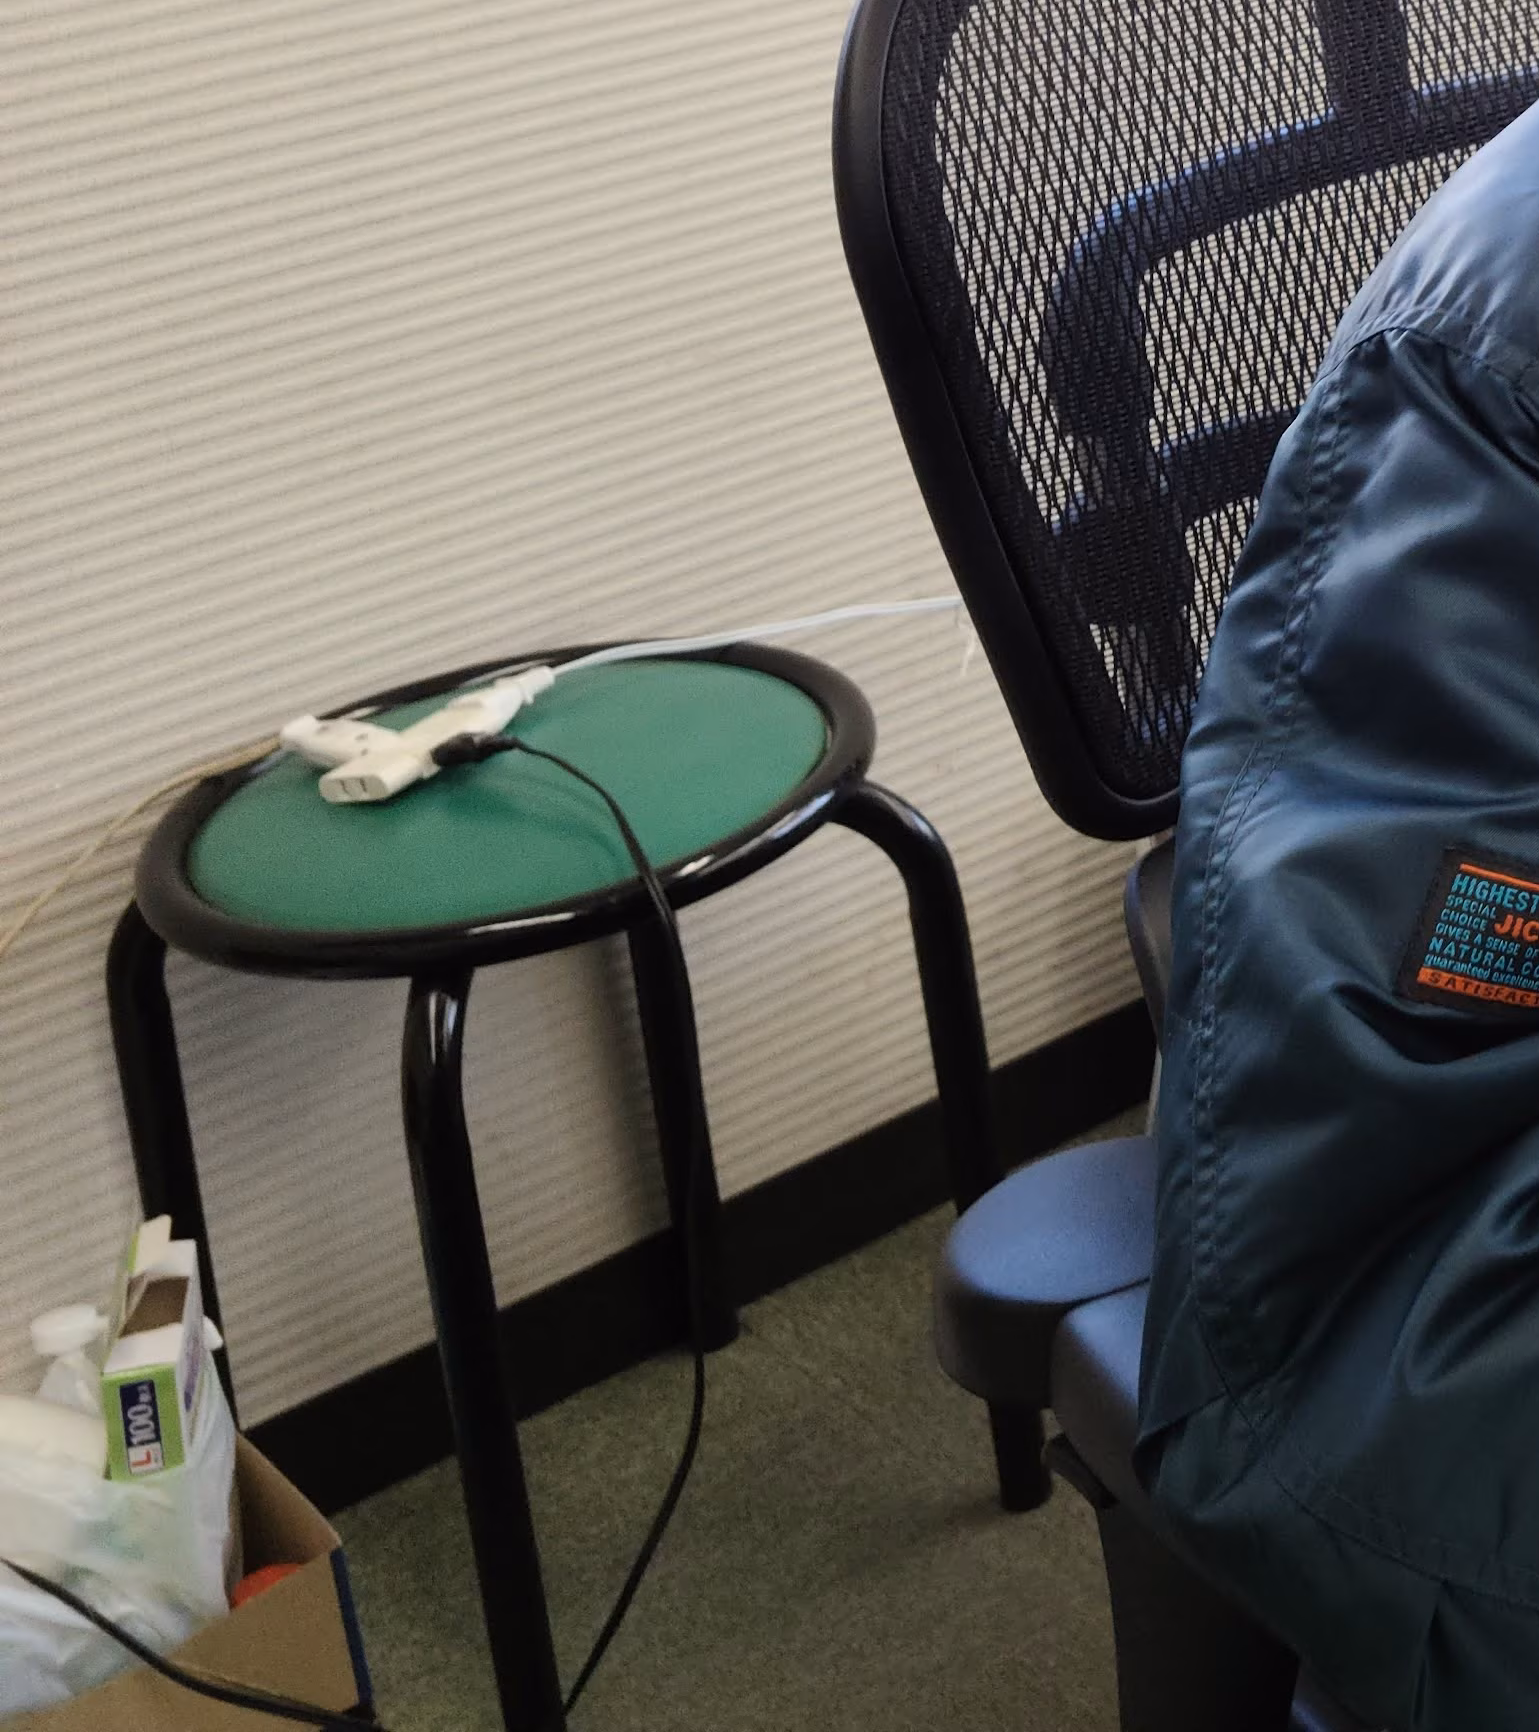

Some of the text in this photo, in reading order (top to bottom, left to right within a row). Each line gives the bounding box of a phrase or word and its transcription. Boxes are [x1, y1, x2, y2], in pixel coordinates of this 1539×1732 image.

[1440, 908, 1488, 932] CHOICE
[1445, 895, 1497, 919] SPECIAL
[1436, 922, 1471, 941] GIVES
[1473, 933, 1482, 945] A
[1486, 936, 1521, 957] SENSE
[1525, 948, 1539, 959] OF
[1424, 954, 1490, 981] guaranteed
[1428, 937, 1514, 973] NATURAL
[127, 1403, 157, 1445] 100
[131, 1450, 151, 1466] L
